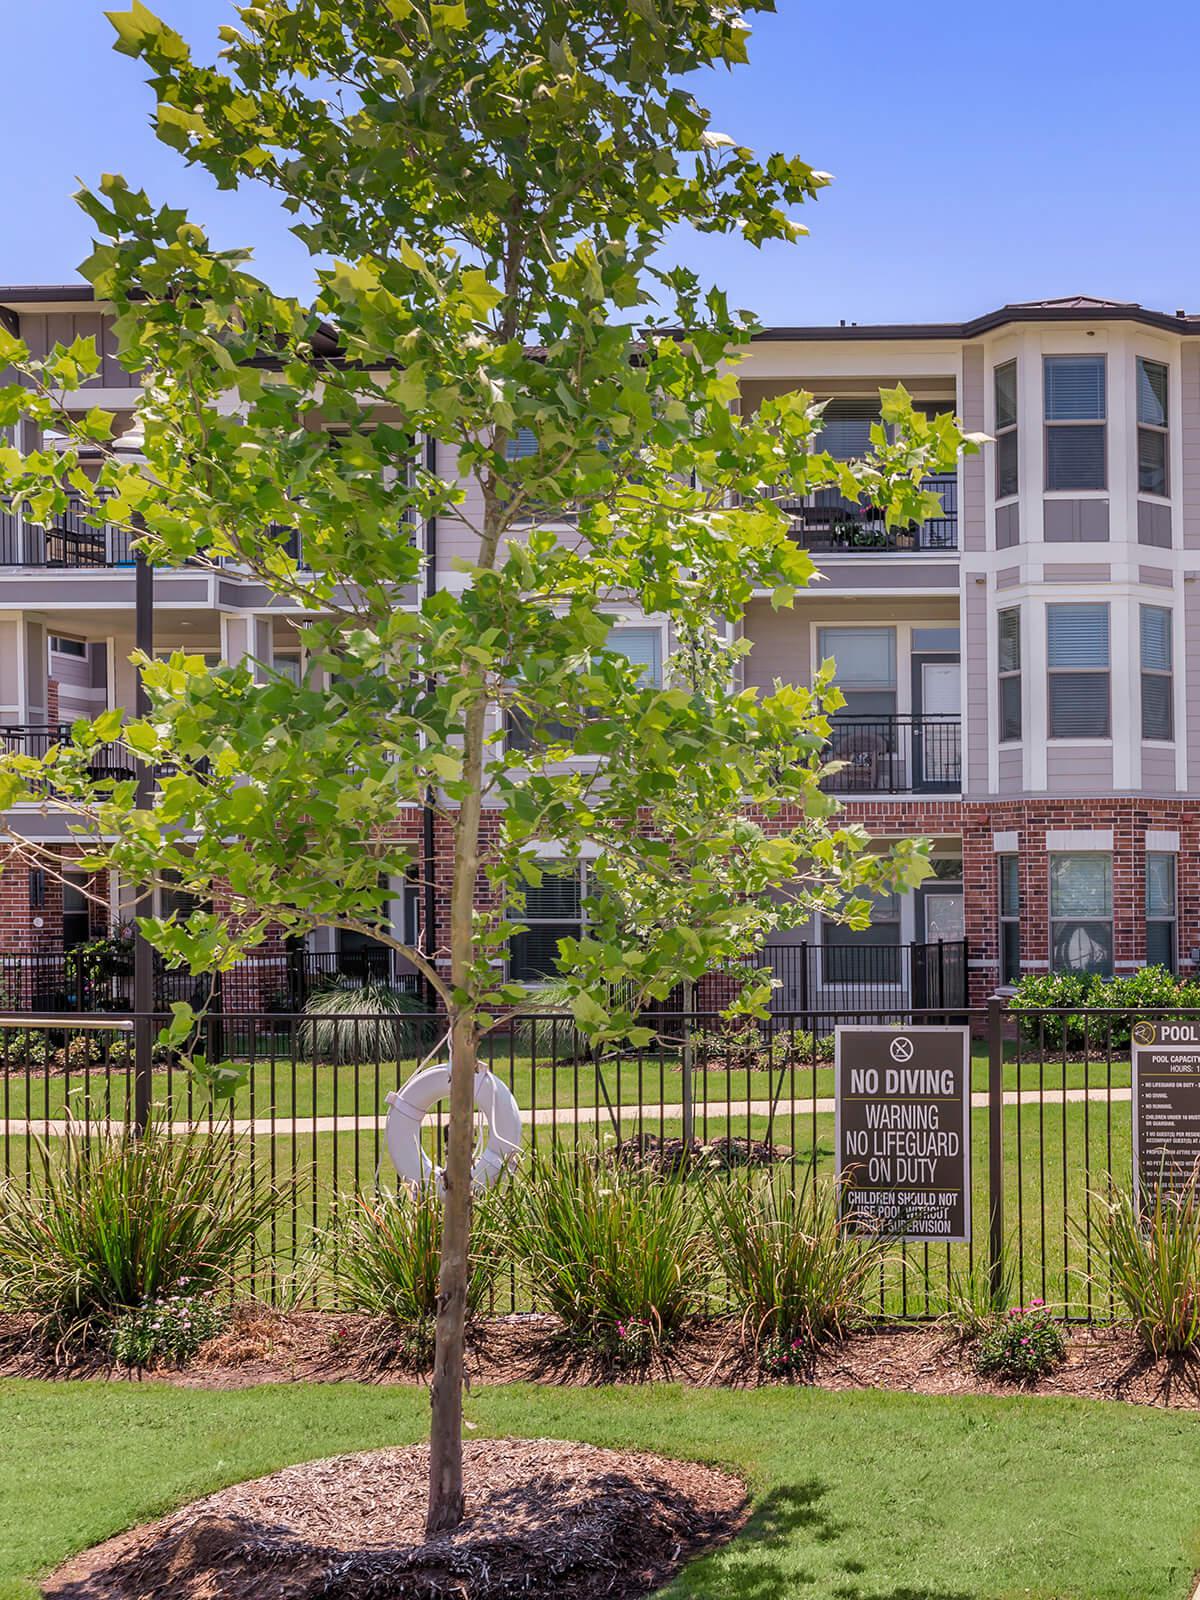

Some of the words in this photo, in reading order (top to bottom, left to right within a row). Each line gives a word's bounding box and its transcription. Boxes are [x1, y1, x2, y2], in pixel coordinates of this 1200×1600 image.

[1161, 1026, 1199, 1041] POOL
[1170, 1065, 1194, 1073] HOURS:
[851, 1069, 879, 1094] NO
[886, 1069, 955, 1095] DIVING
[865, 1104, 939, 1130] WARNING
[846, 1131, 869, 1156] NO
[874, 1131, 959, 1157] LIFEGUARD
[868, 1158, 891, 1182] ON
[896, 1158, 938, 1183] DUTY
[847, 1191, 895, 1205] CHILDREN
[898, 1192, 936, 1206] SHOULD
[939, 1193, 958, 1206] NOT
[857, 1205, 876, 1219] USE
